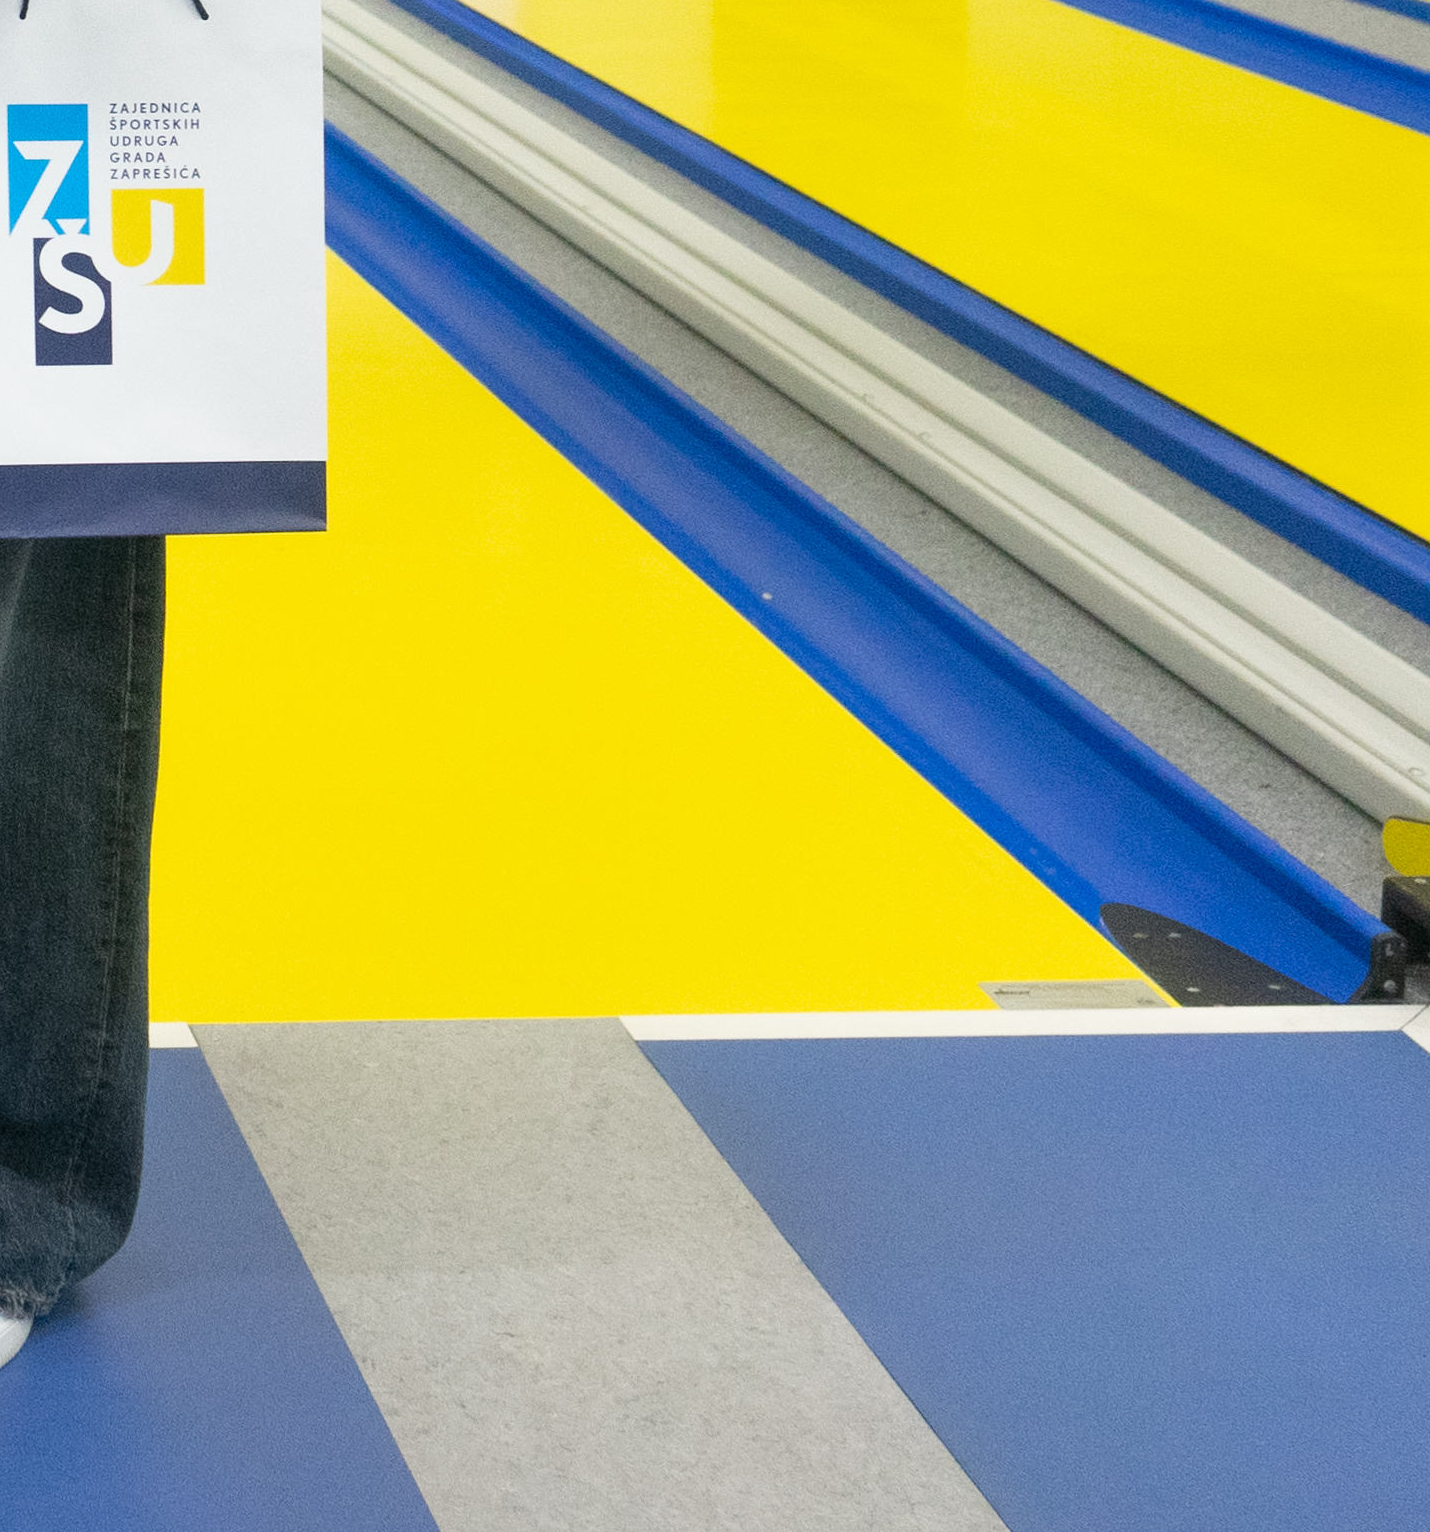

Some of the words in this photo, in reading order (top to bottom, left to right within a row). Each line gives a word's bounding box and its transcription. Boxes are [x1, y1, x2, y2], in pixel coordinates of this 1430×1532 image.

[109, 102, 201, 114] ZAJEDNICA
[109, 117, 200, 130] ŠPORTSKIH
[110, 135, 179, 147] UDRUGA
[109, 152, 166, 163] GRADA
[110, 165, 201, 179] ZAPREŠIĆA
